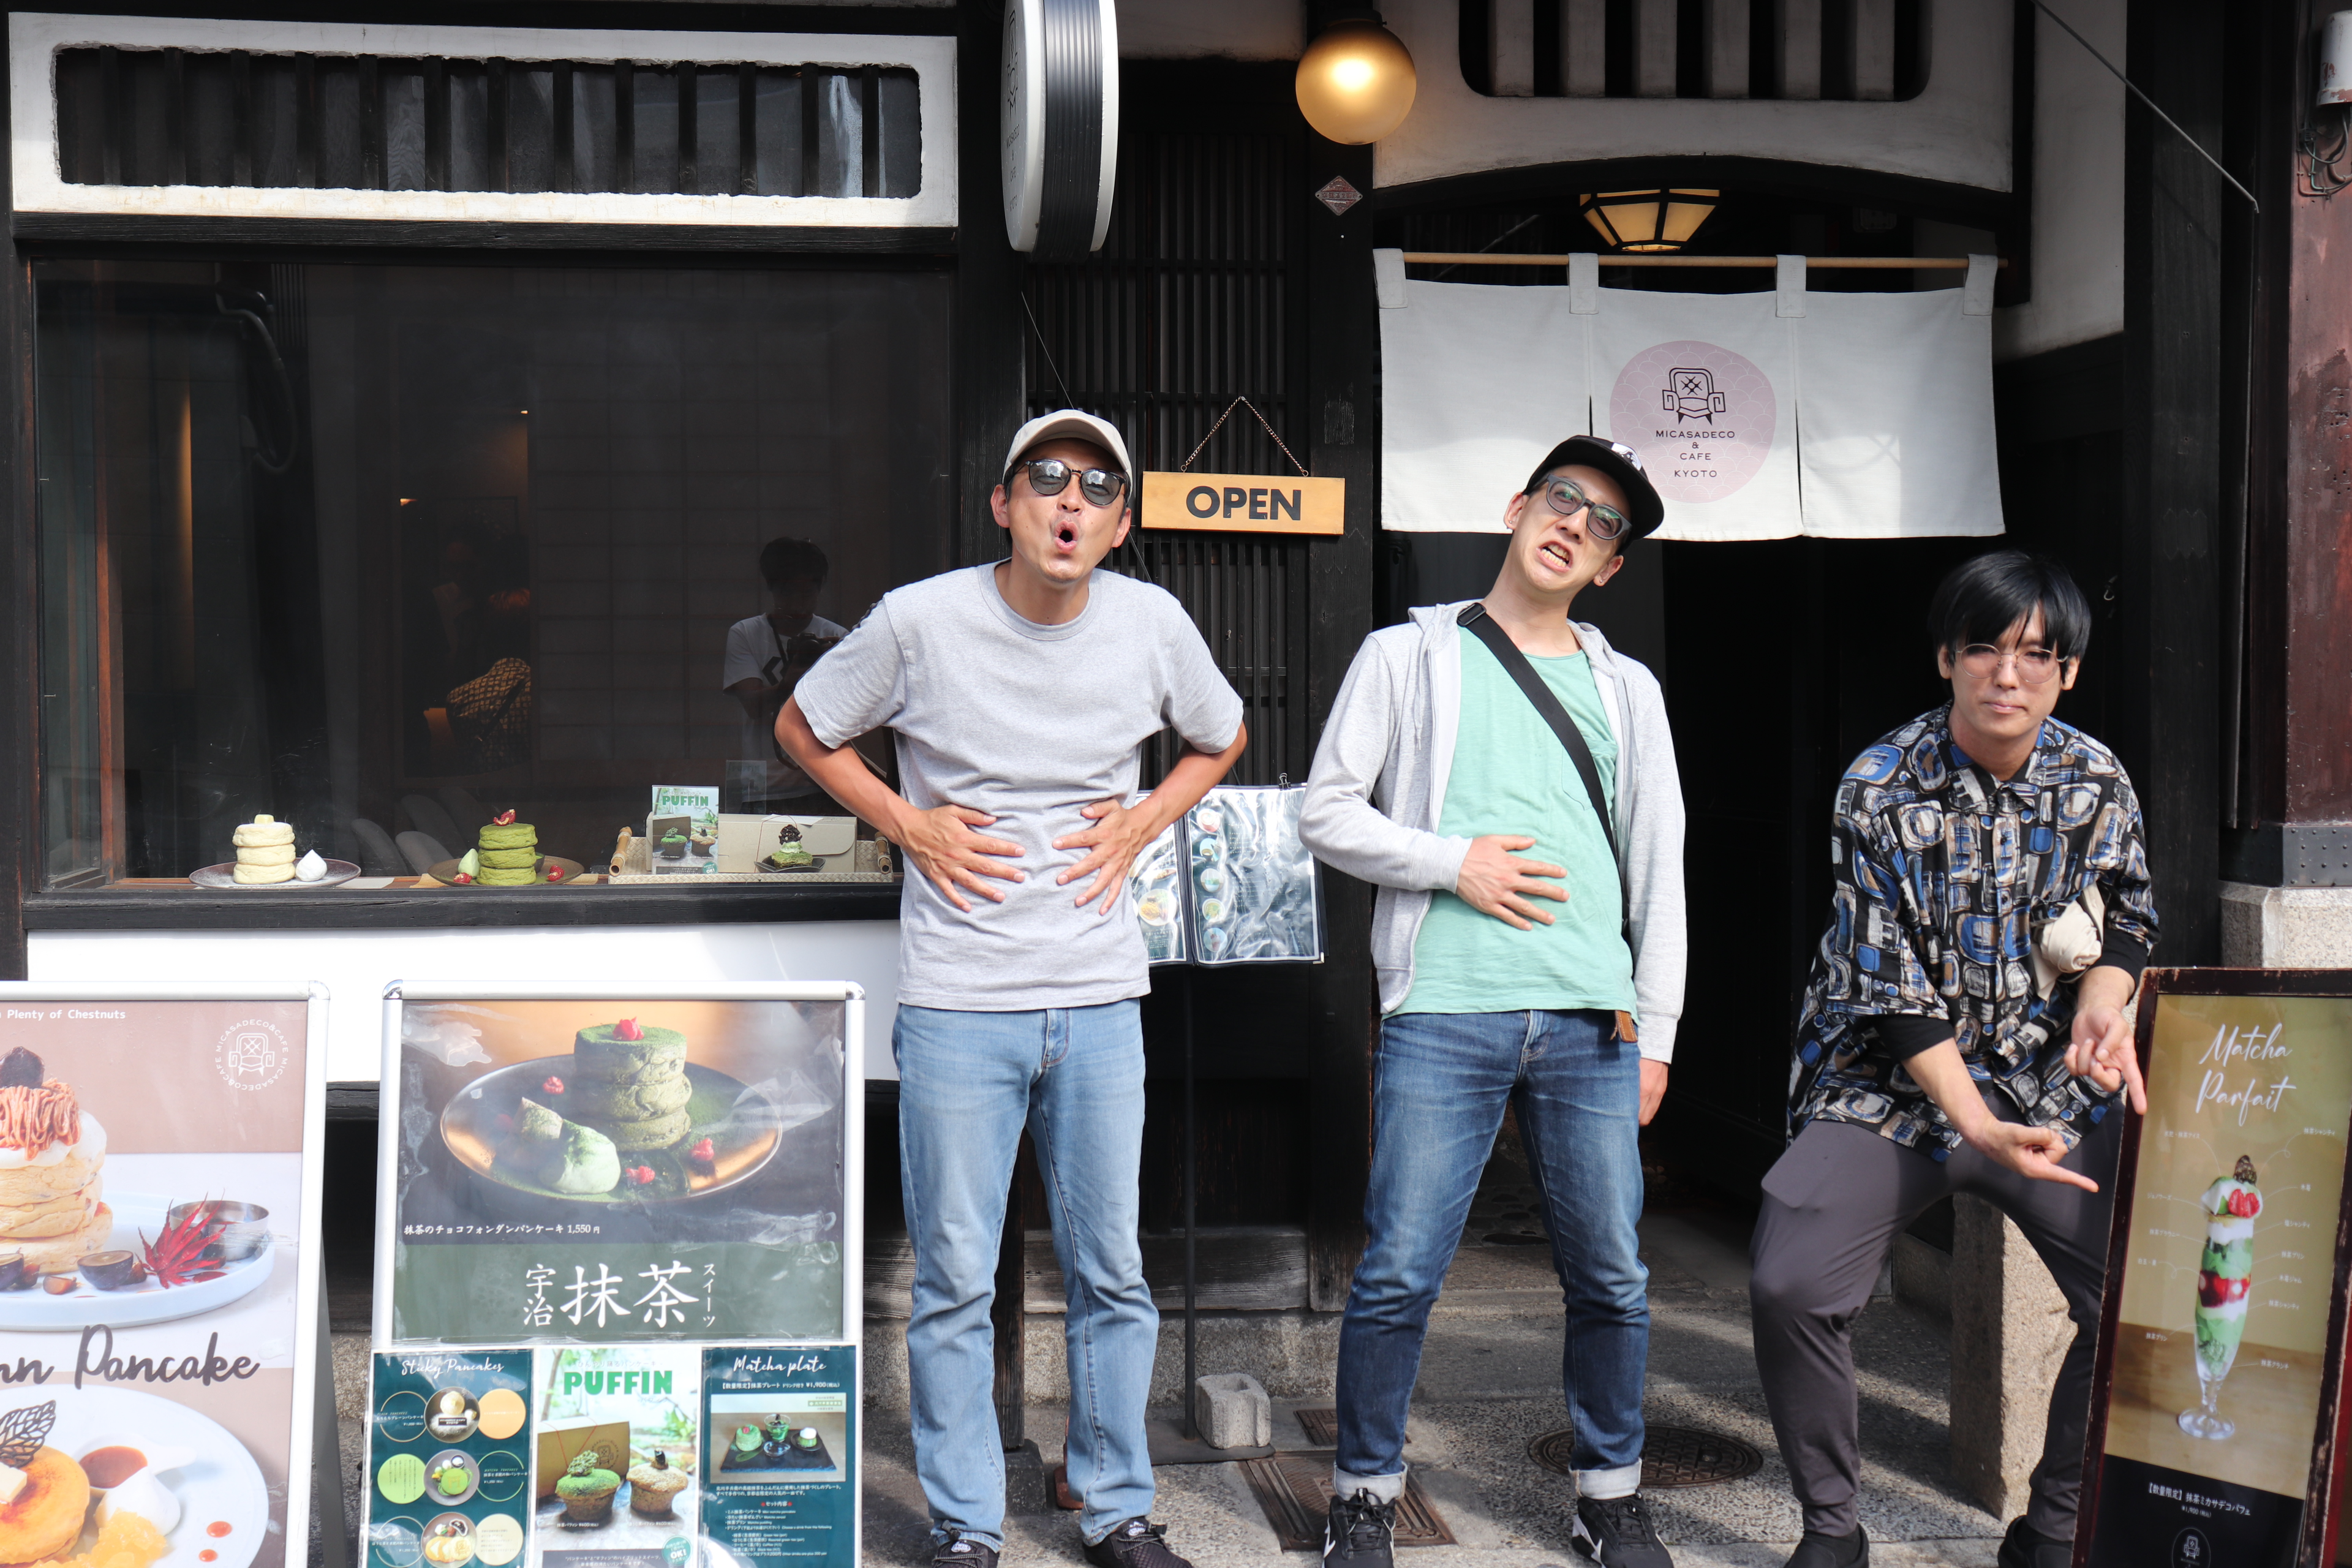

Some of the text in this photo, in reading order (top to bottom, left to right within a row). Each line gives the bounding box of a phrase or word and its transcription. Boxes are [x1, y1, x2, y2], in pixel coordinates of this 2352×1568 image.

[1656, 430, 1735, 439] MICASADECO
[1186, 486, 1302, 521] OPEN
[662, 795, 709, 806] PUFFIN
[7, 1009, 44, 1021] Plenty
[50, 1009, 62, 1019] of
[67, 1009, 126, 1019] Chestnuts
[2199, 1022, 2293, 1067] Matcha
[2195, 1069, 2297, 1127] Parfait
[404, 1224, 564, 1235] 抹茶のチョコフォンダンパンケーキ
[567, 1224, 591, 1234] 1,550
[523, 1264, 556, 1327] 宇治
[560, 1260, 699, 1328] 抹茶
[703, 1264, 715, 1327] スイーツ
[2146, 1332, 2168, 1341] 抹茶プリン
[74, 1324, 260, 1390] Pancake
[402, 1357, 504, 1379] Sticky Pancakes
[733, 1355, 826, 1378] Matcha plate
[2261, 1359, 2289, 1371] 抹茶クランチ
[564, 1370, 673, 1395] PUFFIN
[2185, 1492, 2251, 1516] 抹茶ミカサデコパフェ
[670, 1548, 687, 1559] OK!
